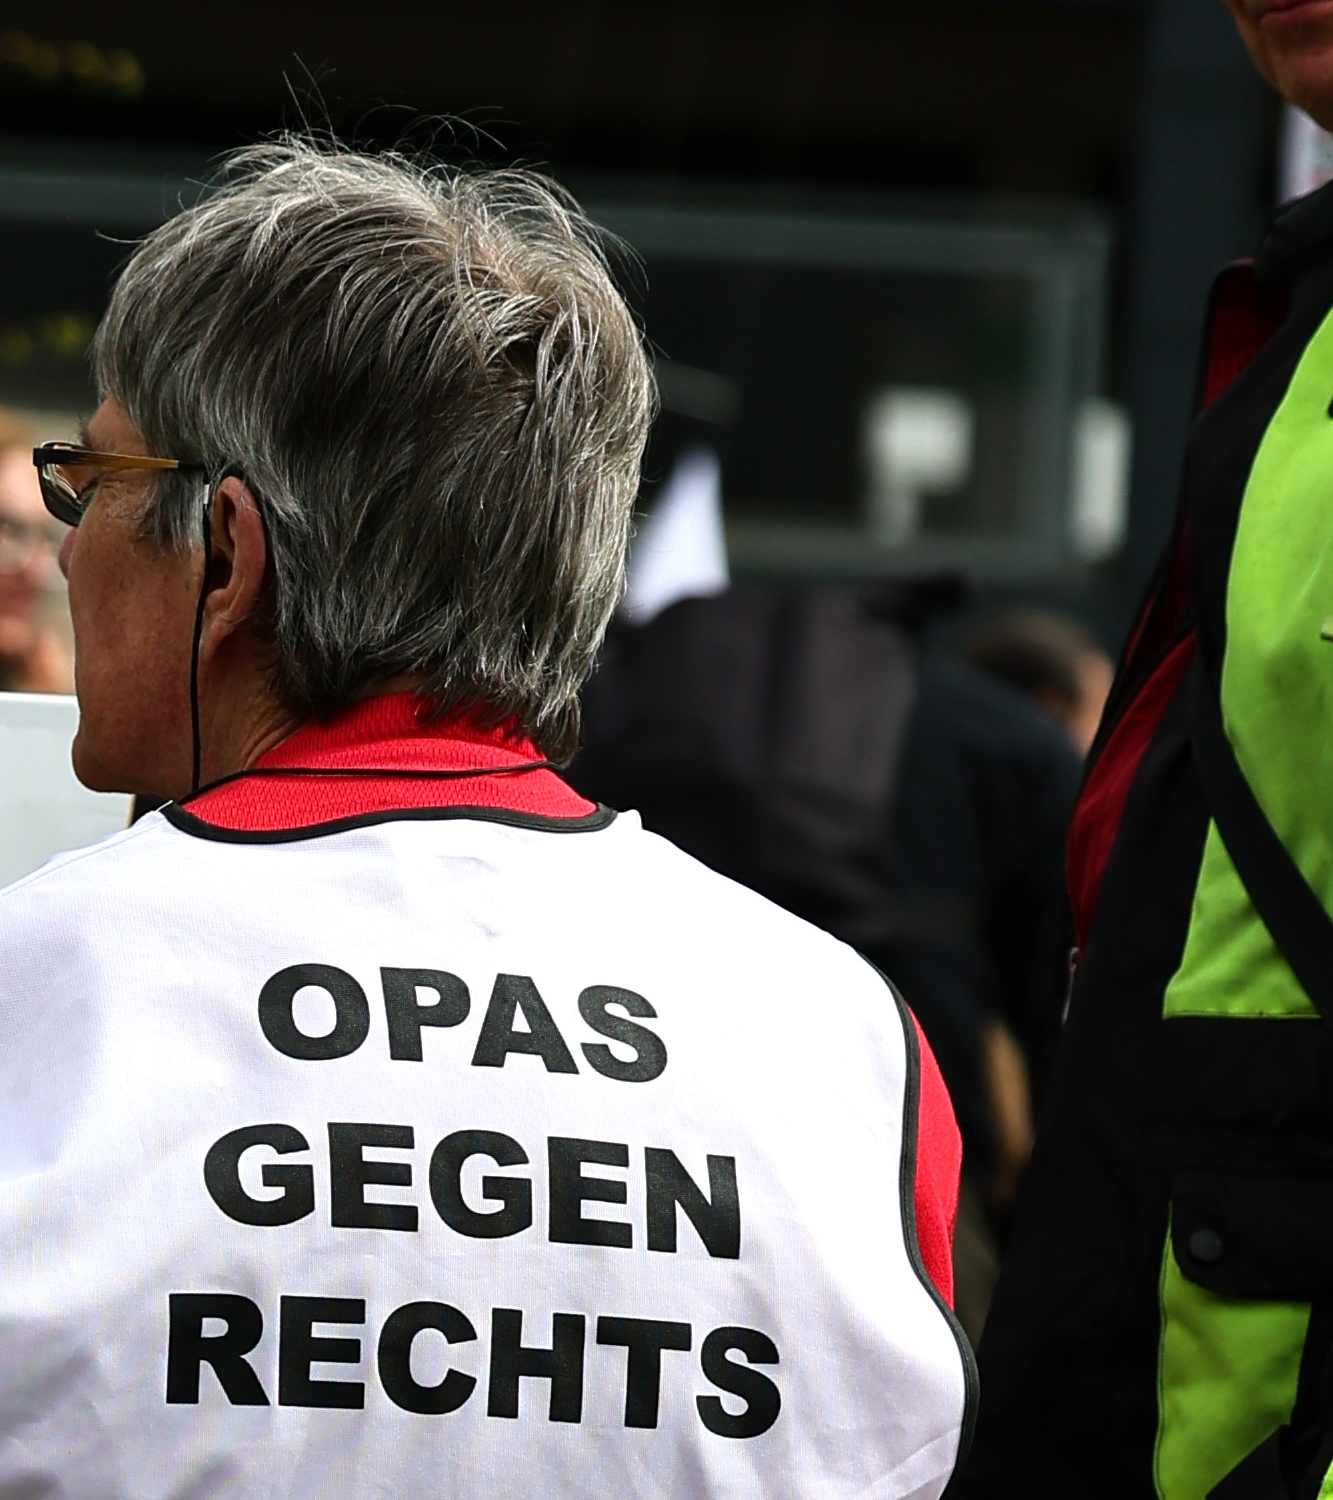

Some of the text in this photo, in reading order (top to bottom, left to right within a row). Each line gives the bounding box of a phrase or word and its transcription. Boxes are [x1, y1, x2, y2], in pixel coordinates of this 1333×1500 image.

[257, 962, 669, 1083] OPAS
[202, 1121, 742, 1261] GEGEN
[165, 1292, 783, 1440] RECHTS
